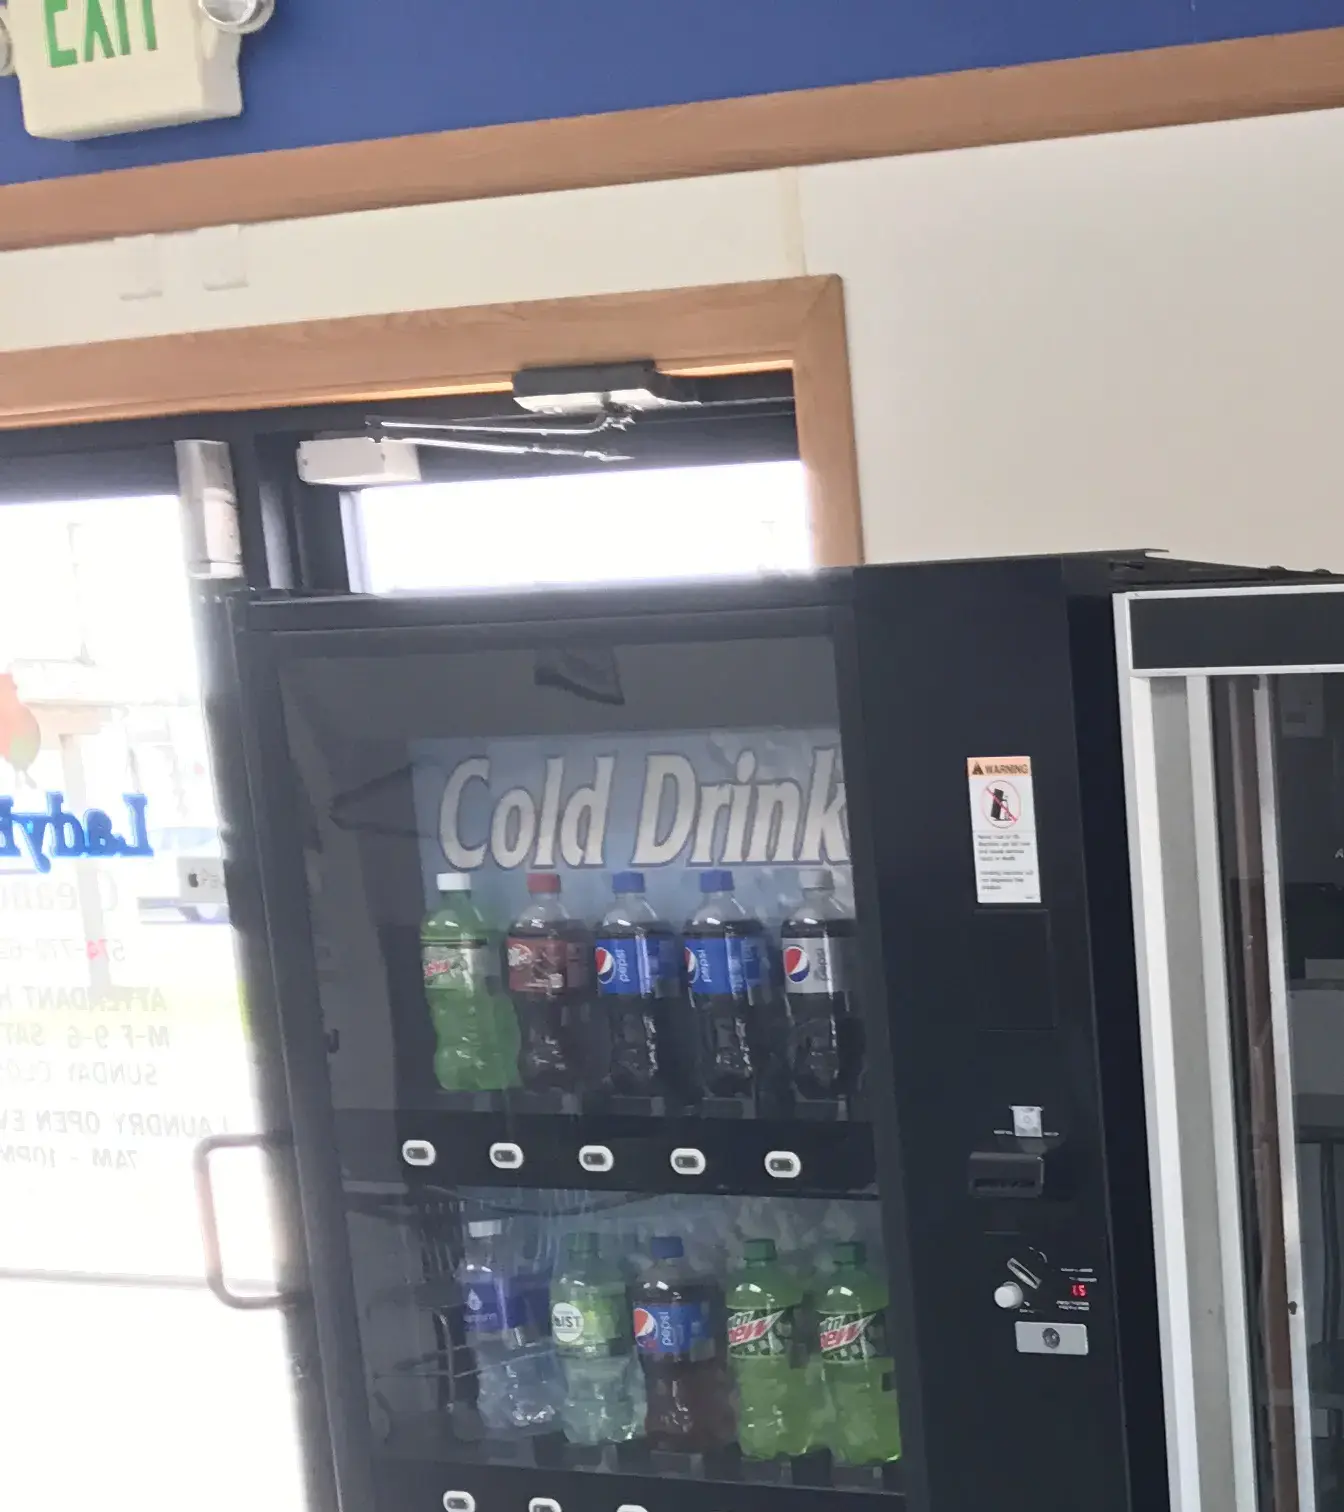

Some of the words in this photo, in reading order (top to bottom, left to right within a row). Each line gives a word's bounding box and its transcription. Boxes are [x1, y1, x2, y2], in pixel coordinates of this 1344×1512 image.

[984, 763, 1028, 775] WARNING
[438, 755, 616, 871] Cold
[659, 1310, 676, 1347] pepsi
